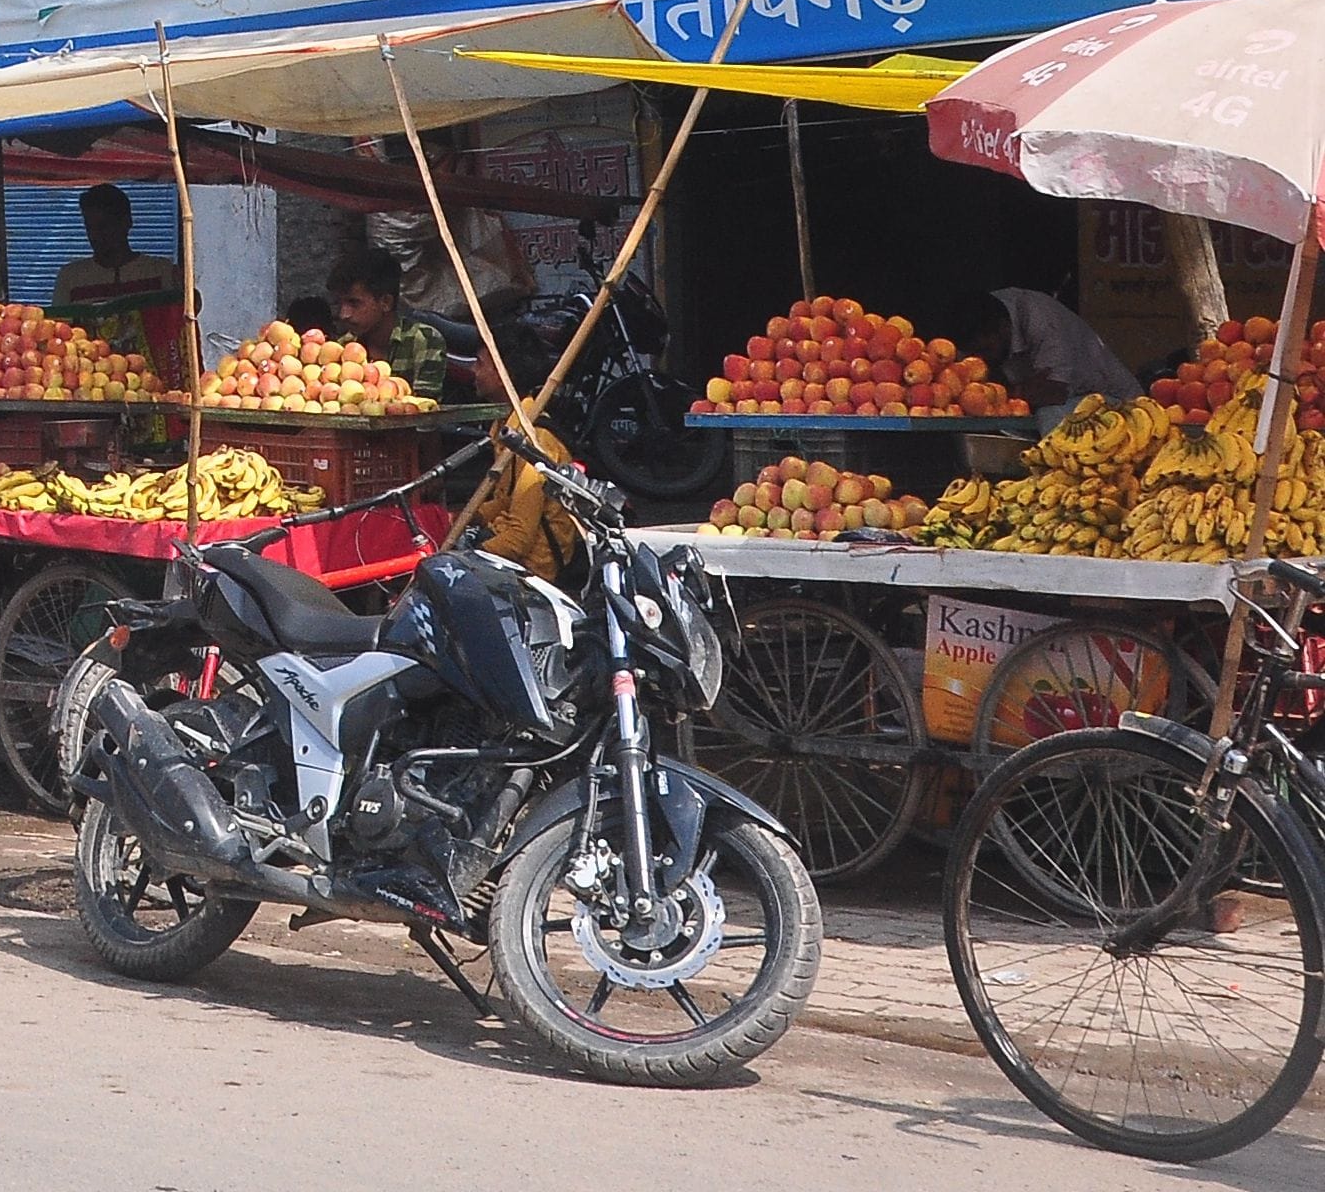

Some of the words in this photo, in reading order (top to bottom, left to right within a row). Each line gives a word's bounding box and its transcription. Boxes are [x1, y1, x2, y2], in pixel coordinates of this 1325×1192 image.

[1196, 57, 1290, 91] airtel
[1180, 89, 1254, 128] 4G
[936, 637, 997, 666] Apple
[274, 665, 320, 712] Apache
[359, 800, 382, 815] TVS
